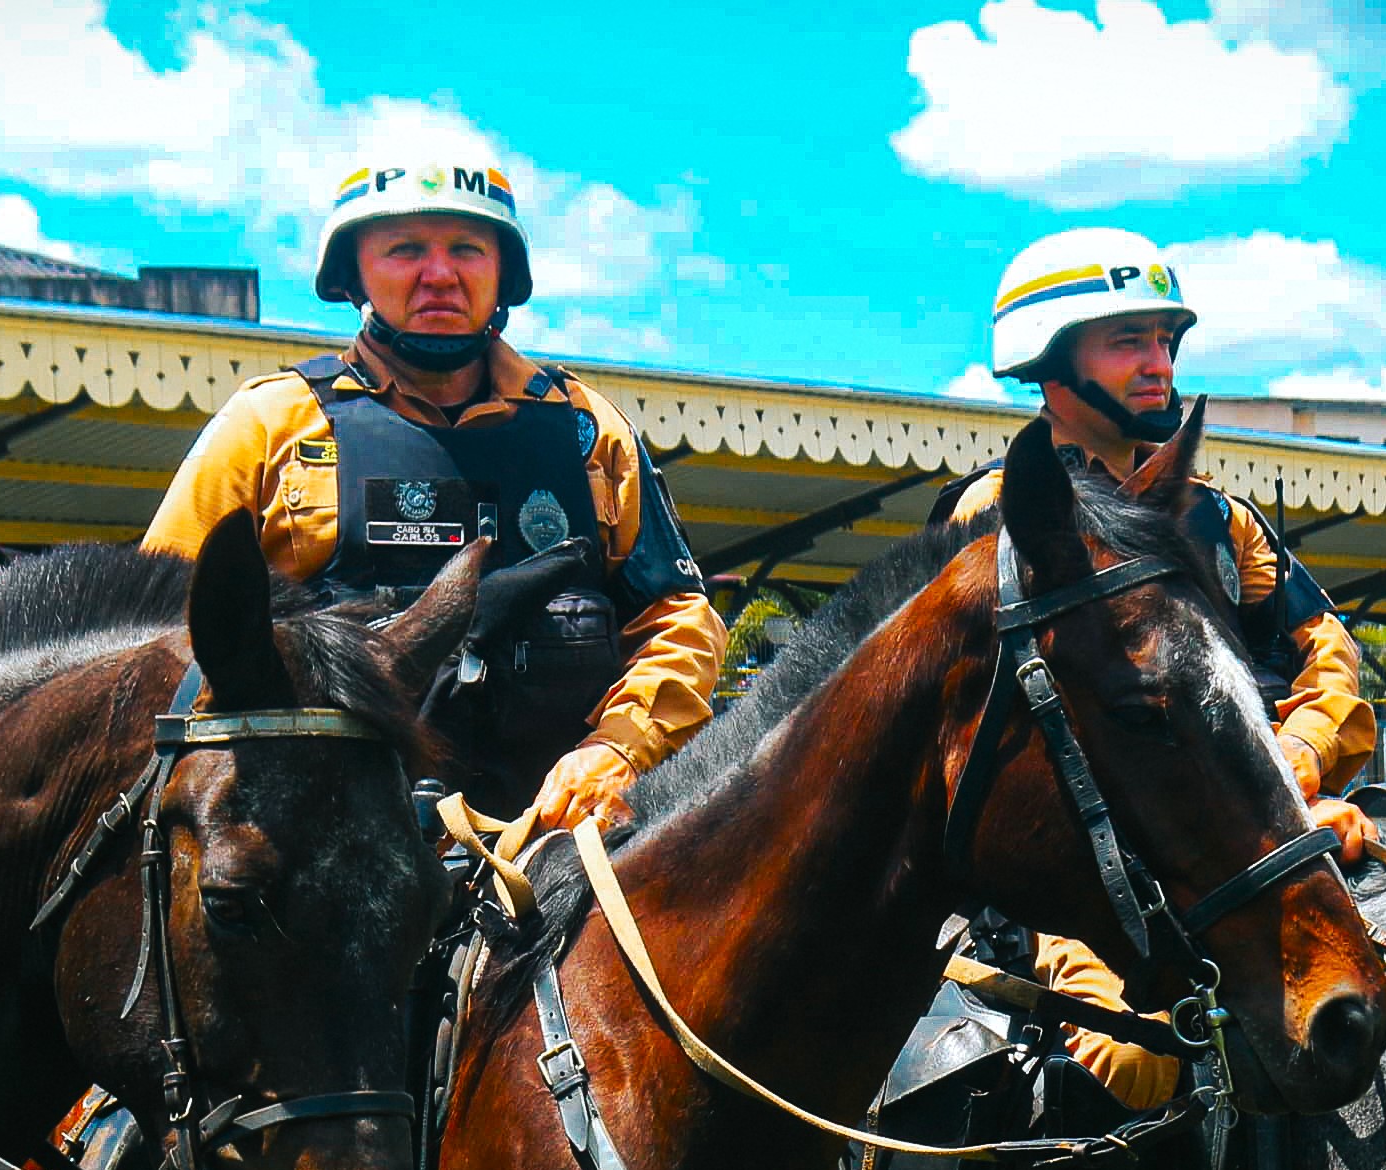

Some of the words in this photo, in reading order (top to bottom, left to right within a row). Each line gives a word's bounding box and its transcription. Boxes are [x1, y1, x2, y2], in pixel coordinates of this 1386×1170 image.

[375, 167, 406, 192] P
[453, 167, 486, 196] M
[1109, 265, 1141, 291] P
[392, 532, 441, 542] CARLOS
